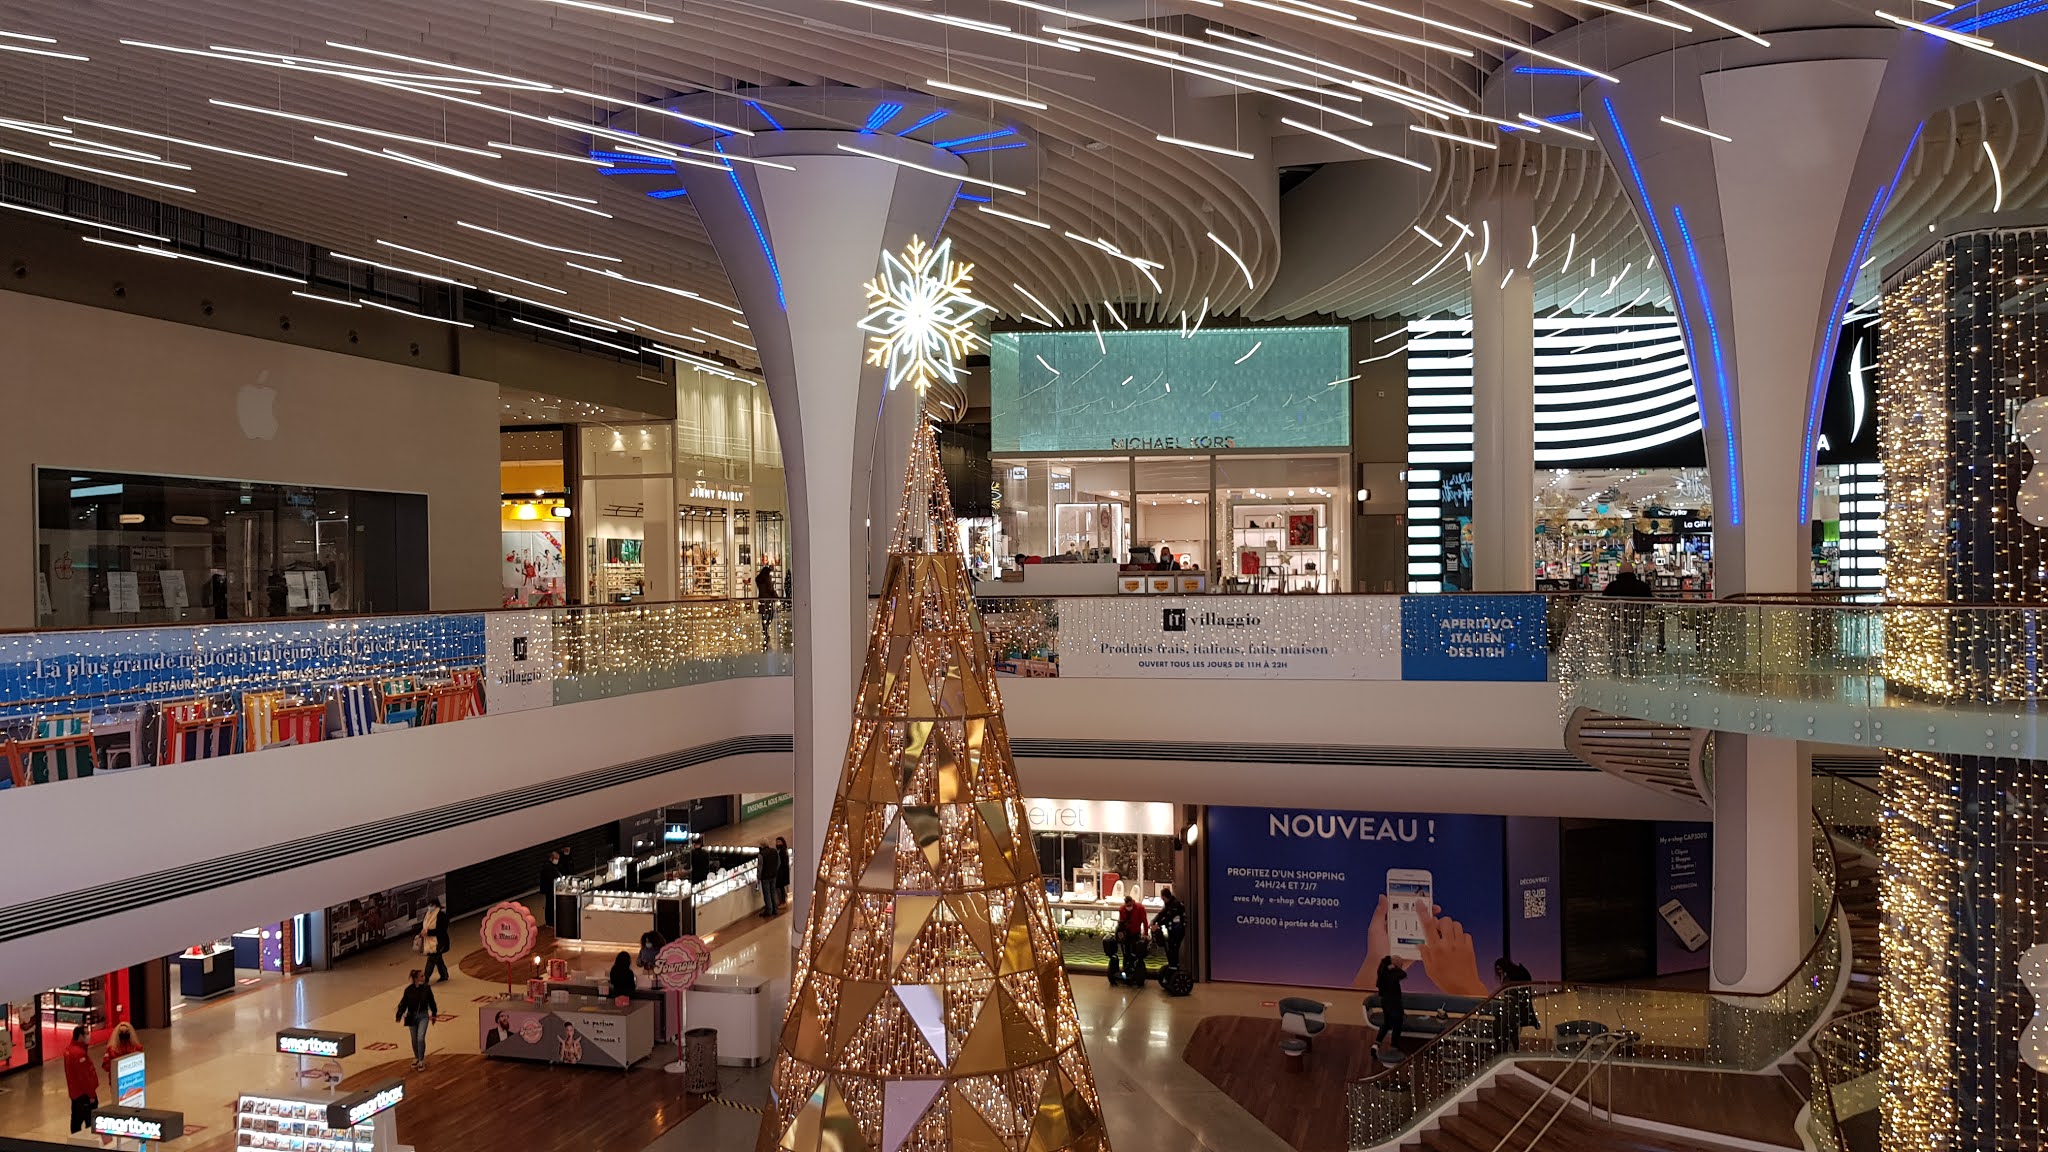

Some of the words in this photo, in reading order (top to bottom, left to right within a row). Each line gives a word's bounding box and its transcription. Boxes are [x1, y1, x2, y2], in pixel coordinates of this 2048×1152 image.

[1111, 436, 1182, 450] MICHAEL
[1190, 435, 1235, 449] KORS
[690, 487, 715, 499] JINNY
[717, 489, 743, 501] FAIRLY
[1189, 612, 1260, 629] villaggio
[1441, 618, 1513, 629] APERITIVO
[1450, 632, 1502, 643] ITALIEN
[1101, 643, 1153, 654] Produits
[1193, 643, 1245, 655] italiens,
[1249, 643, 1276, 655] faits
[1280, 643, 1328, 655] maison
[1480, 647, 1505, 657] 18H
[36, 659, 61, 679] La
[67, 656, 109, 682] plus
[112, 653, 175, 679] grande
[179, 647, 248, 668] trattoria
[251, 642, 316, 663] italienne
[319, 641, 337, 657] de
[339, 639, 351, 656] la
[1207, 661, 1232, 669] JOURS
[1247, 661, 1261, 669] 11H
[1263, 659, 1270, 668] À
[1271, 661, 1288, 669] 22H
[145, 677, 213, 693] RESTAURANT
[220, 674, 240, 686] BAR
[277, 667, 320, 681] TERRASSE
[338, 664, 367, 675] PLACES
[500, 668, 542, 685] villaggio
[1029, 807, 1084, 827] erret
[1269, 813, 1418, 843] NOUVEAU
[1427, 819, 1436, 843] !
[1227, 867, 1270, 878] PROFITEZ
[1272, 869, 1294, 879] D'UN
[1296, 871, 1345, 881] SHOPPING
[1254, 880, 1286, 889] 24H/24
[1288, 882, 1298, 890] ET
[1300, 882, 1317, 891] 7J/7
[1251, 894, 1264, 905] My
[1269, 895, 1295, 906] e-shop
[1297, 896, 1340, 907] CAP3000
[1236, 915, 1277, 925] CAP3000
[1279, 918, 1284, 926] à
[1284, 919, 1308, 929] portée
[1309, 919, 1318, 928] de
[1320, 920, 1333, 928] clic
[280, 1036, 339, 1055] smartbox
[349, 1084, 404, 1123] smartbox
[95, 1115, 162, 1137] smartbox
